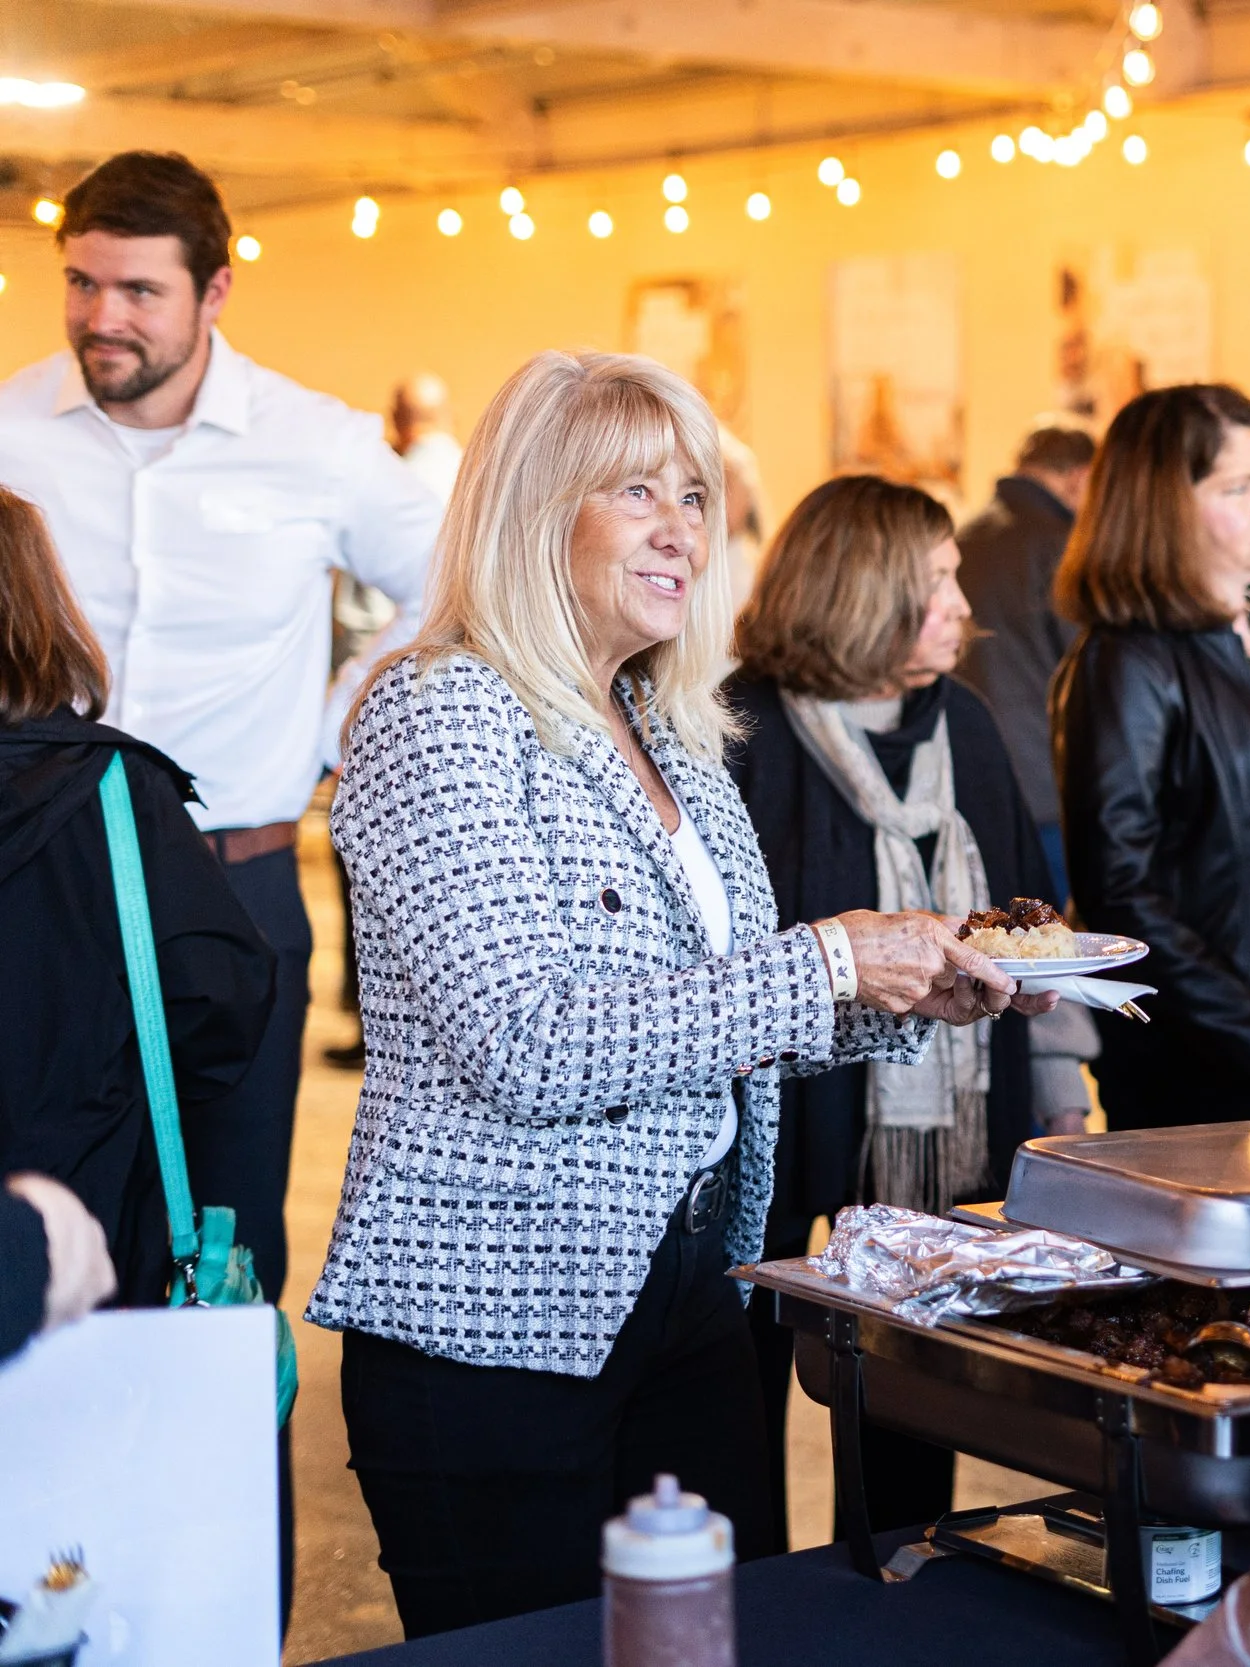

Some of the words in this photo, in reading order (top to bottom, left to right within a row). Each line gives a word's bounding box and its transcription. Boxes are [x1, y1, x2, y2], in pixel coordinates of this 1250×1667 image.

[1156, 1568, 1185, 1576] Chafing
[1156, 1576, 1173, 1584] Dish
[1175, 1575, 1190, 1583] Fuel
